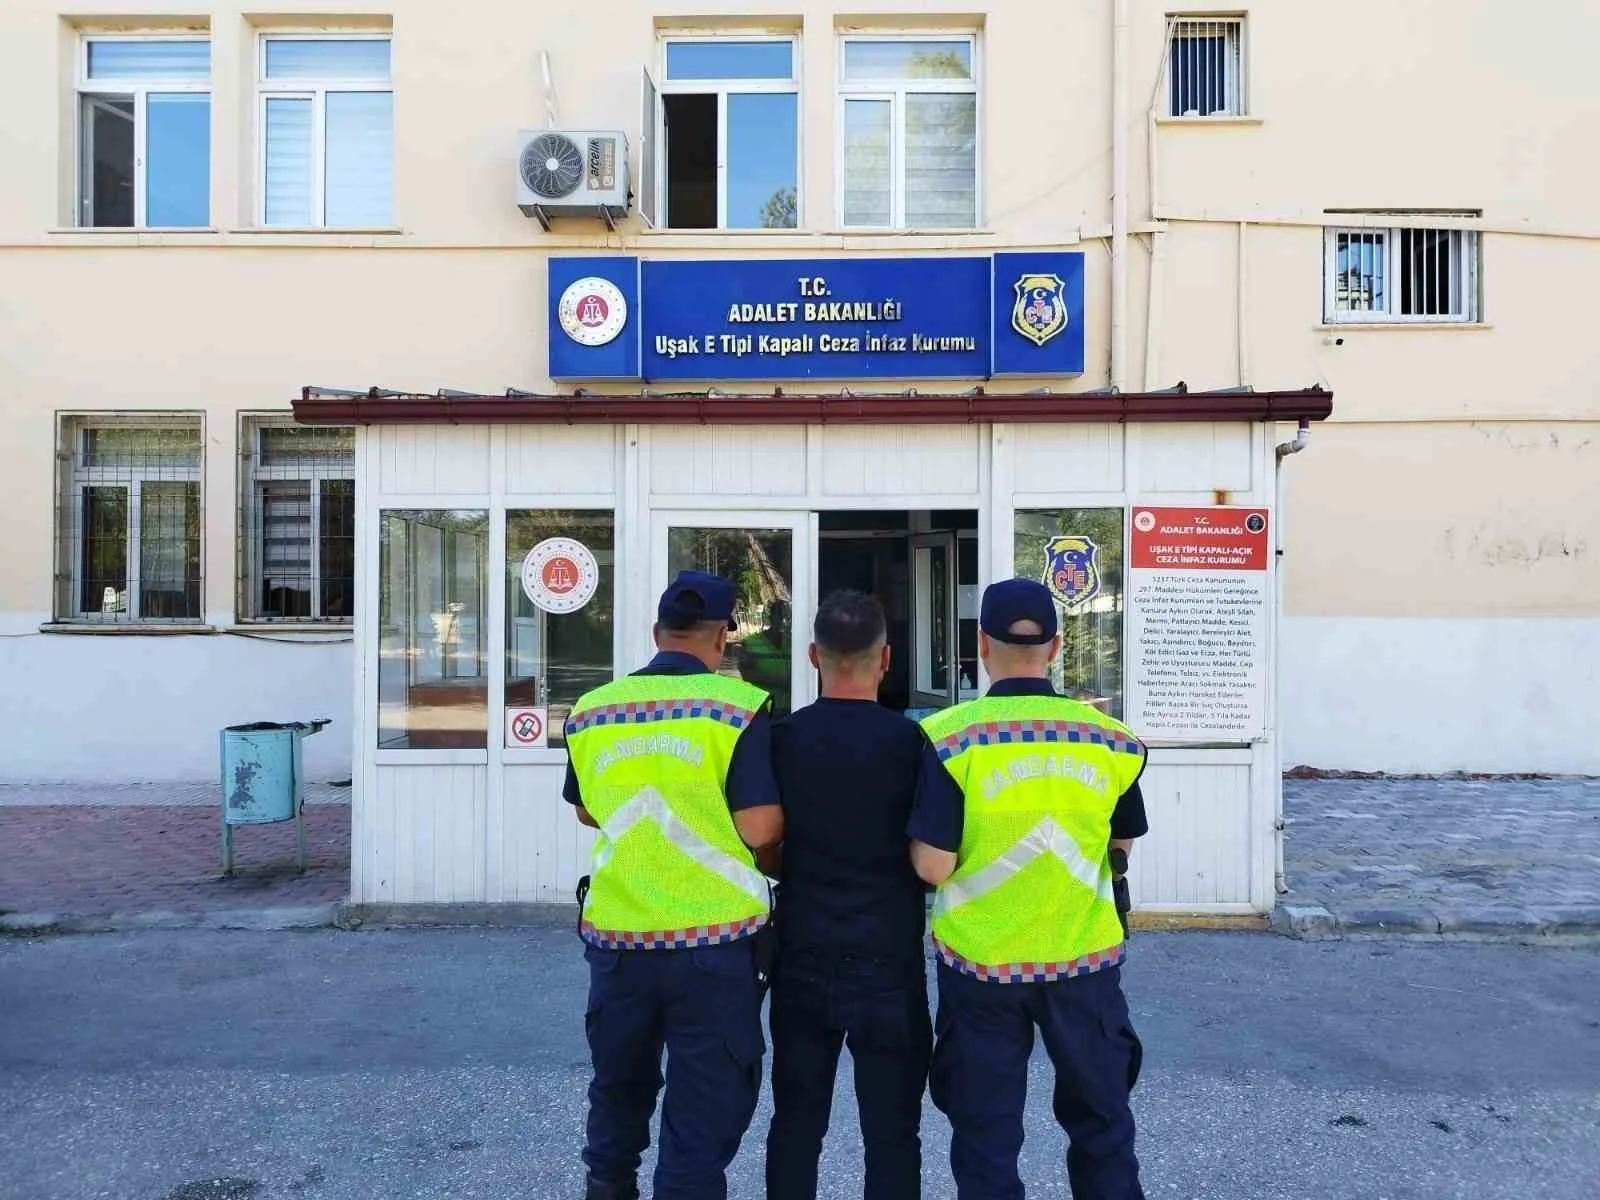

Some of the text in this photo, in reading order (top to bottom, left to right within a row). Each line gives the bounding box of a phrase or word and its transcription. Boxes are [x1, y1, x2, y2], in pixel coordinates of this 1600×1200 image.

[798, 277, 831, 296] T.C.
[728, 299, 902, 322] ADALET BAKANLIĞI
[655, 330, 976, 357] Uşak E Tipi Kapalı Ceza İnfaz Kurumu
[1193, 517, 1209, 525] T.C.
[1196, 526, 1243, 535] BAKANLIĞI
[1150, 545, 1174, 554] UŞAK
[1182, 544, 1199, 554] TİPİ
[1200, 546, 1253, 556] KAPALI-AÇIK
[1156, 553, 1247, 565] CEZA İNFAZ KURUMU
[594, 733, 704, 777] JANDARMA
